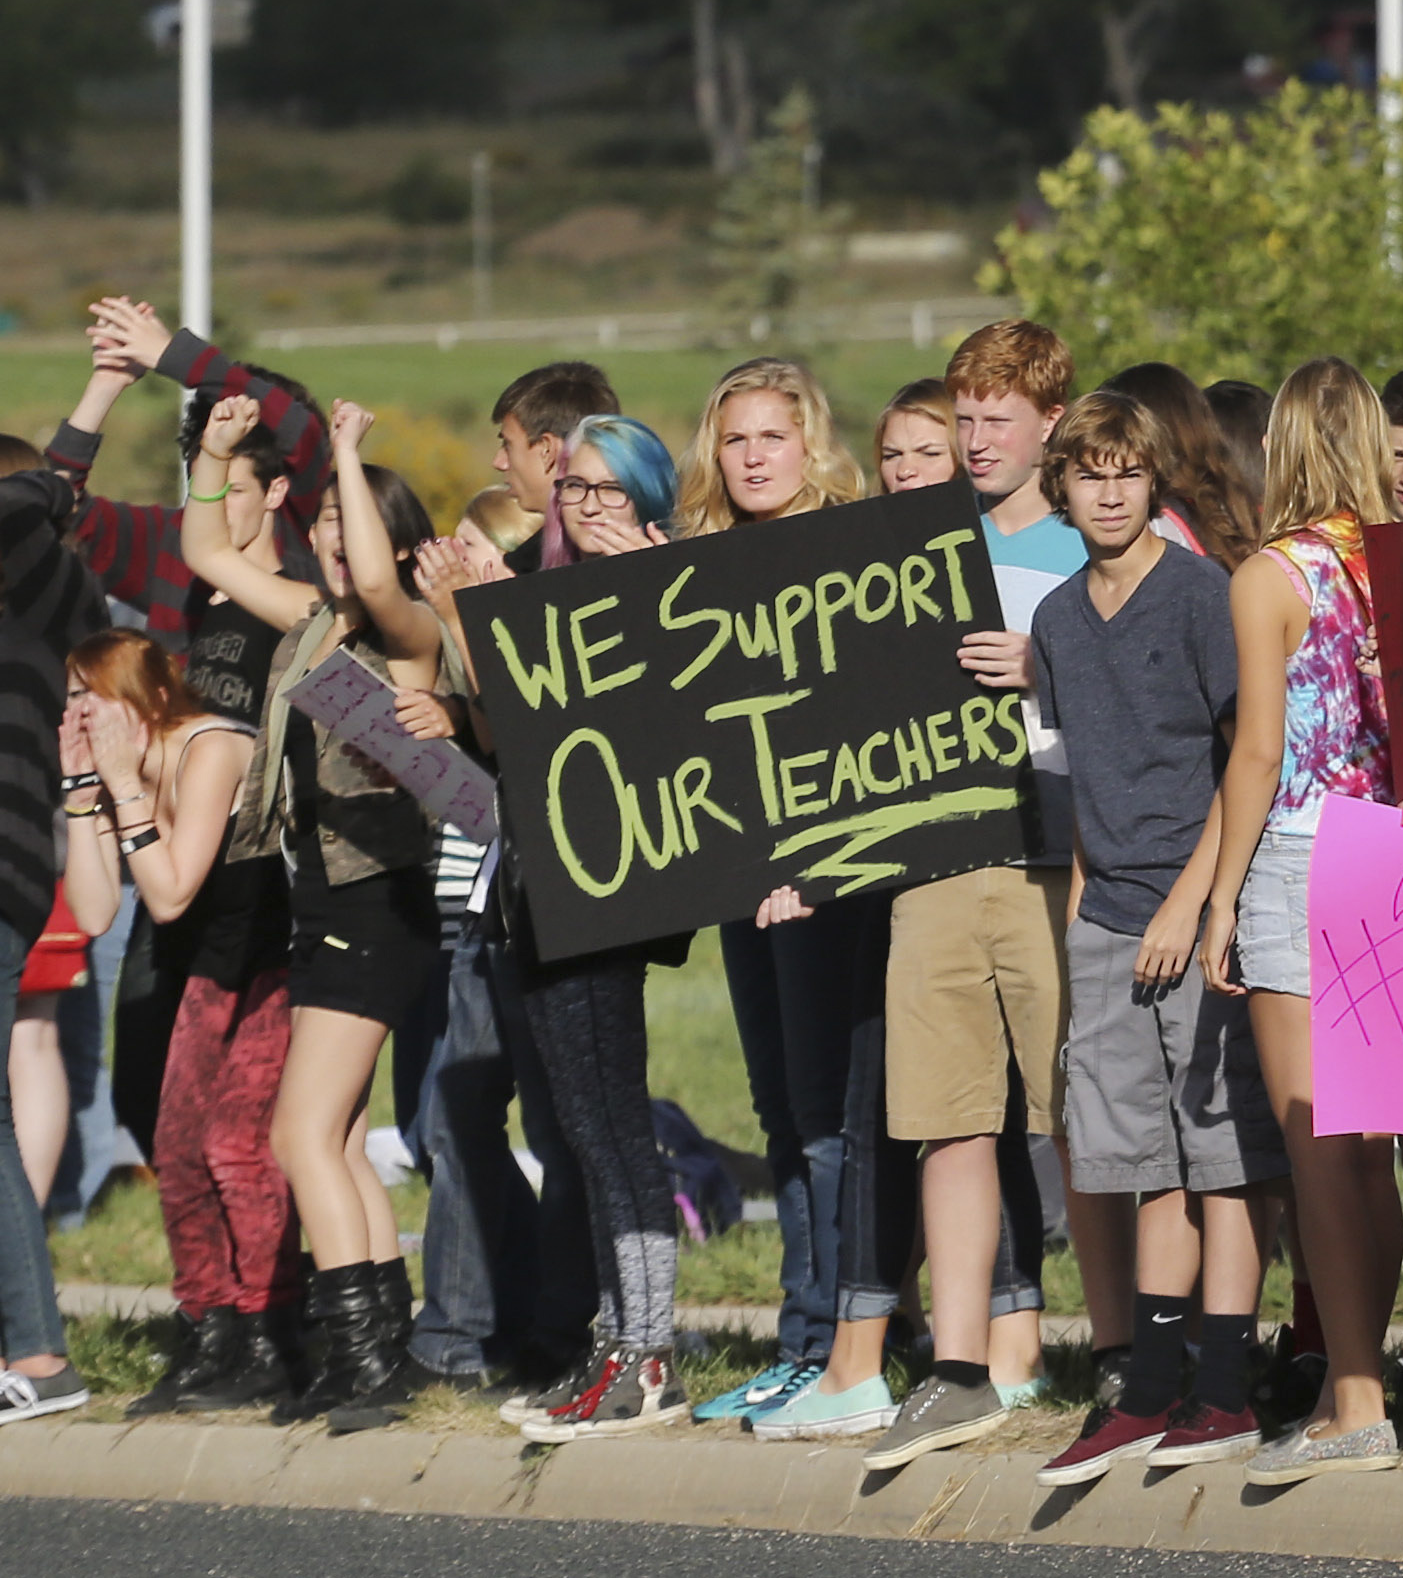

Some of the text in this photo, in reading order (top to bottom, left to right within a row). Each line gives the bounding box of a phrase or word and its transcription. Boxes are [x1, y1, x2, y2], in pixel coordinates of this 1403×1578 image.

[491, 529, 977, 710] WE SUPPORT
[547, 728, 744, 898] OUR
[706, 688, 1027, 827] TEACHERS
